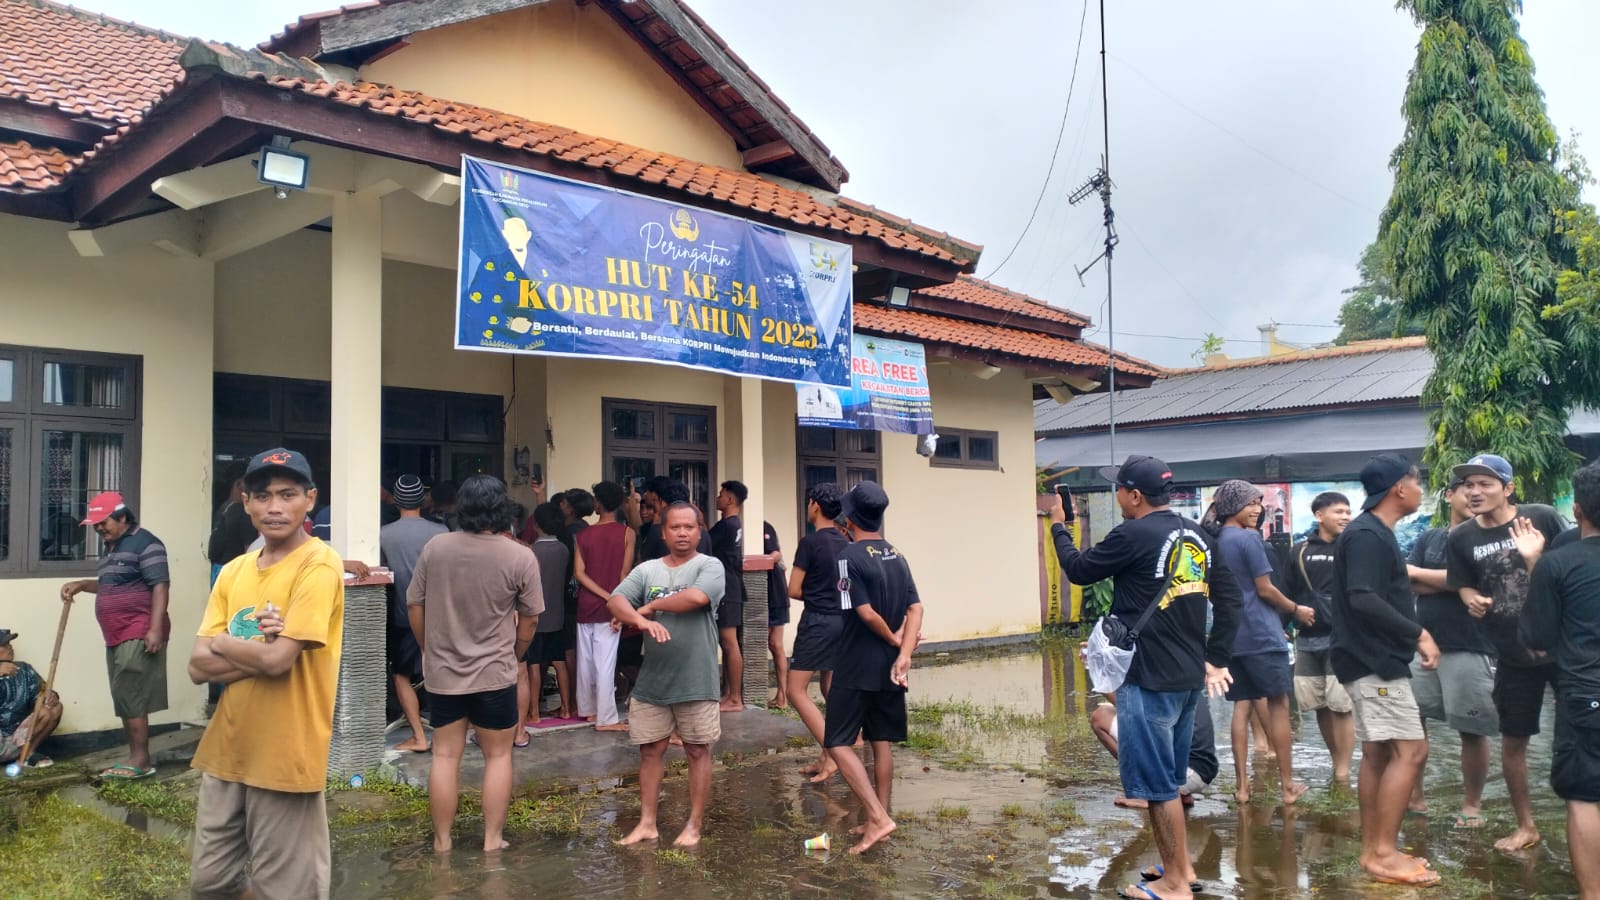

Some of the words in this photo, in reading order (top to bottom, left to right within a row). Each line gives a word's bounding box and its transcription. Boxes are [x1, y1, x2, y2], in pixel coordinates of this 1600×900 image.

[639, 221, 732, 275] Peringatan
[605, 256, 672, 292] HUT
[517, 278, 653, 322] KORPRI
[664, 298, 752, 341] TAHUN
[761, 317, 818, 350] 2025
[533, 321, 582, 336] Bersatu,
[585, 326, 639, 341] Berdaulat,
[641, 332, 681, 345] Bersama
[683, 338, 712, 350] KORPRI
[714, 344, 760, 359] Mewujudkan
[762, 352, 798, 364] Indonesia
[800, 358, 817, 368] Maju
[852, 357, 879, 376] REA
[883, 362, 918, 381] FREE
